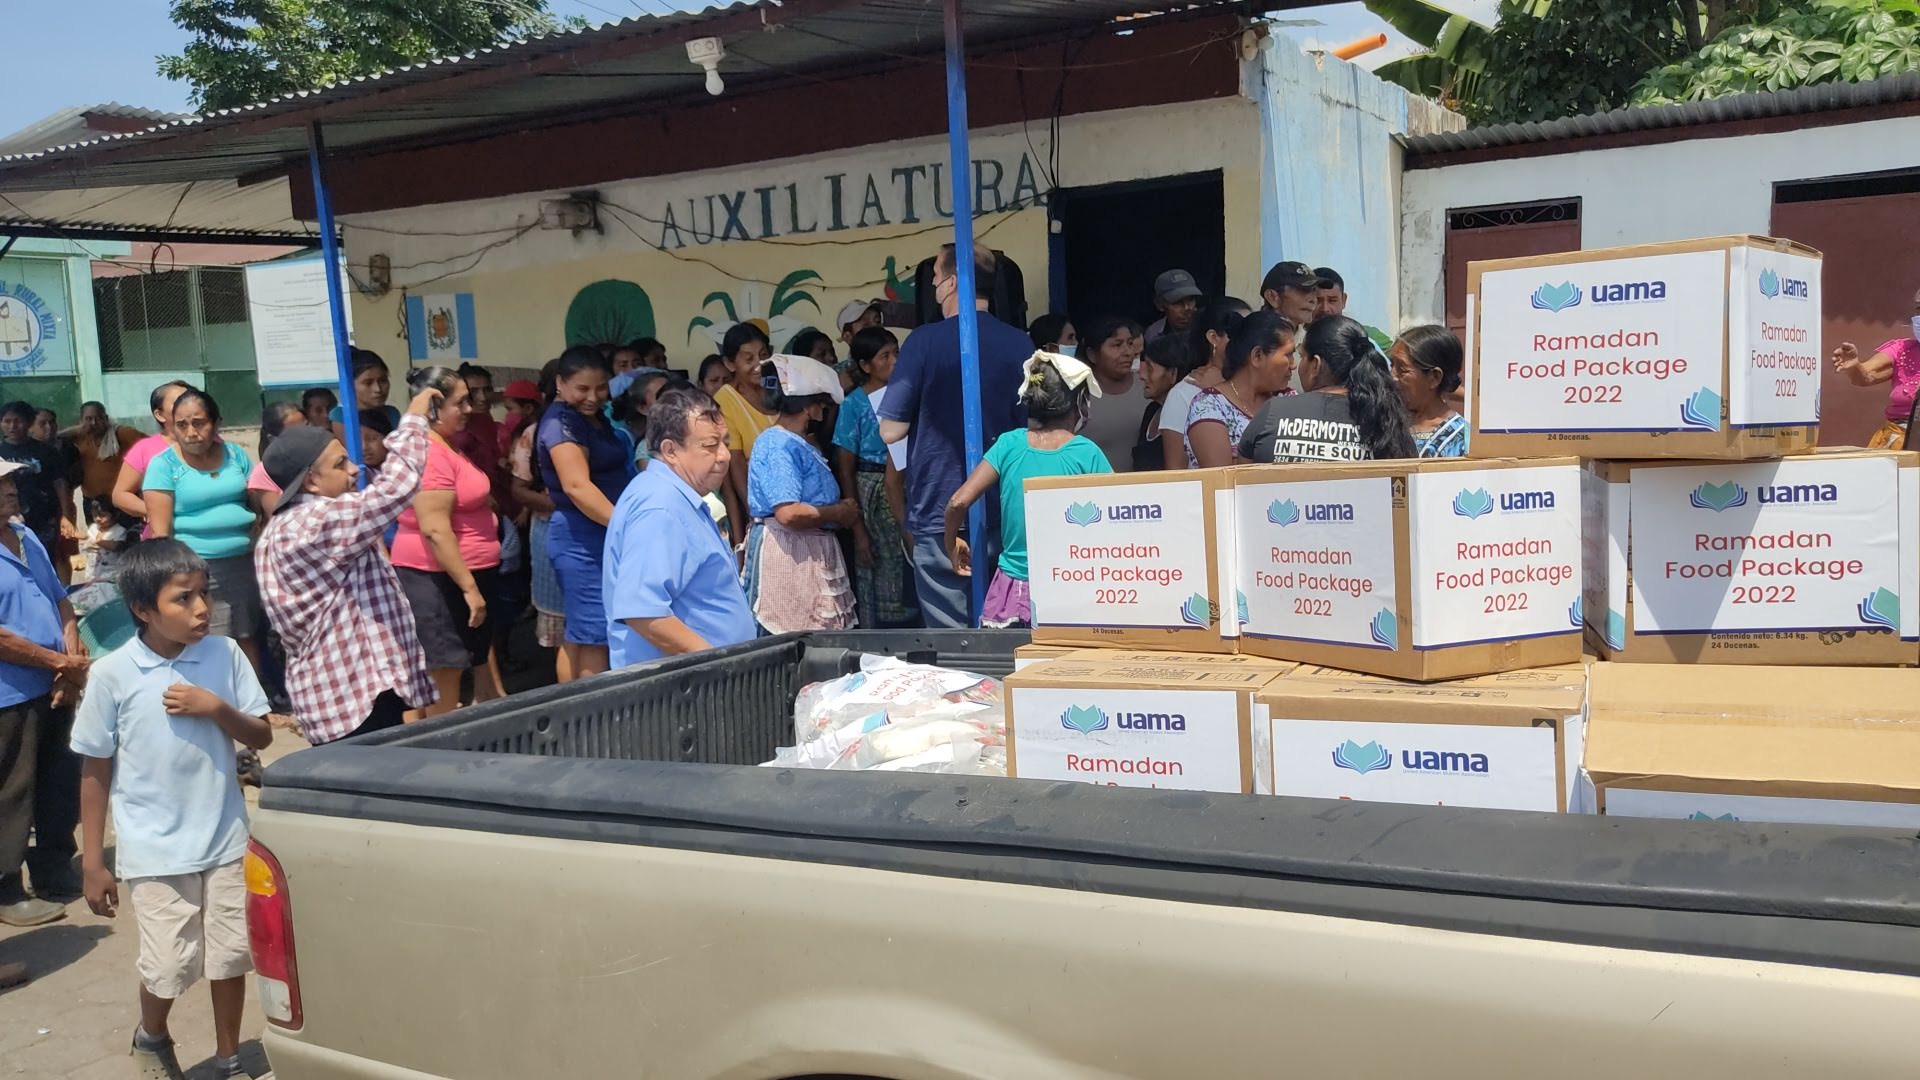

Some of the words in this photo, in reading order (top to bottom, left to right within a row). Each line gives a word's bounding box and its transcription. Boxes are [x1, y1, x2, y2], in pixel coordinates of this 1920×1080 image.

[658, 152, 1048, 250] AUXILIATURA
[1591, 280, 1666, 303] uama
[1782, 276, 1808, 298] uama
[40, 313, 57, 340] MIXTA
[1761, 321, 1808, 343] Ramadan
[1533, 329, 1659, 352] Ramadan
[1507, 359, 1565, 379] Food
[1574, 357, 1688, 380] Package
[1751, 350, 1776, 370] Food
[1778, 351, 1817, 376] Package
[1564, 385, 1622, 404] 2022
[1775, 379, 1797, 397] 2022
[1277, 417, 1361, 442] McDERMOTT'S
[1547, 433, 1557, 441] 24
[1275, 441, 1291, 453] IN
[1297, 443, 1326, 456] THE
[1331, 446, 1372, 461] SQUA
[1500, 490, 1555, 511] uama
[1757, 483, 1838, 504] uama
[1108, 504, 1162, 521] uama
[1305, 503, 1354, 521] uama
[1069, 543, 1160, 559] Ramadan
[1457, 537, 1552, 560] Ramadan
[1695, 530, 1832, 552] Ramadan
[1271, 547, 1352, 565] Ramadan
[1052, 567, 1094, 582] Food
[1100, 566, 1183, 586] Package
[1436, 568, 1484, 590] Food
[1490, 564, 1573, 586] Package
[1665, 560, 1732, 579] Food
[1742, 558, 1863, 581] Package
[1256, 571, 1293, 588] Food
[1299, 573, 1373, 598] Package
[1731, 585, 1796, 604] 2022
[1095, 589, 1138, 604] 2022
[1294, 598, 1332, 616] 2022
[1484, 592, 1528, 614] 2022
[1711, 632, 1751, 640] Contenido
[1753, 632, 1774, 640] neto:
[1796, 632, 1809, 641] kg.
[1116, 711, 1186, 731] uama
[1066, 753, 1183, 776] Ramadan
[1402, 749, 1489, 773] uama
